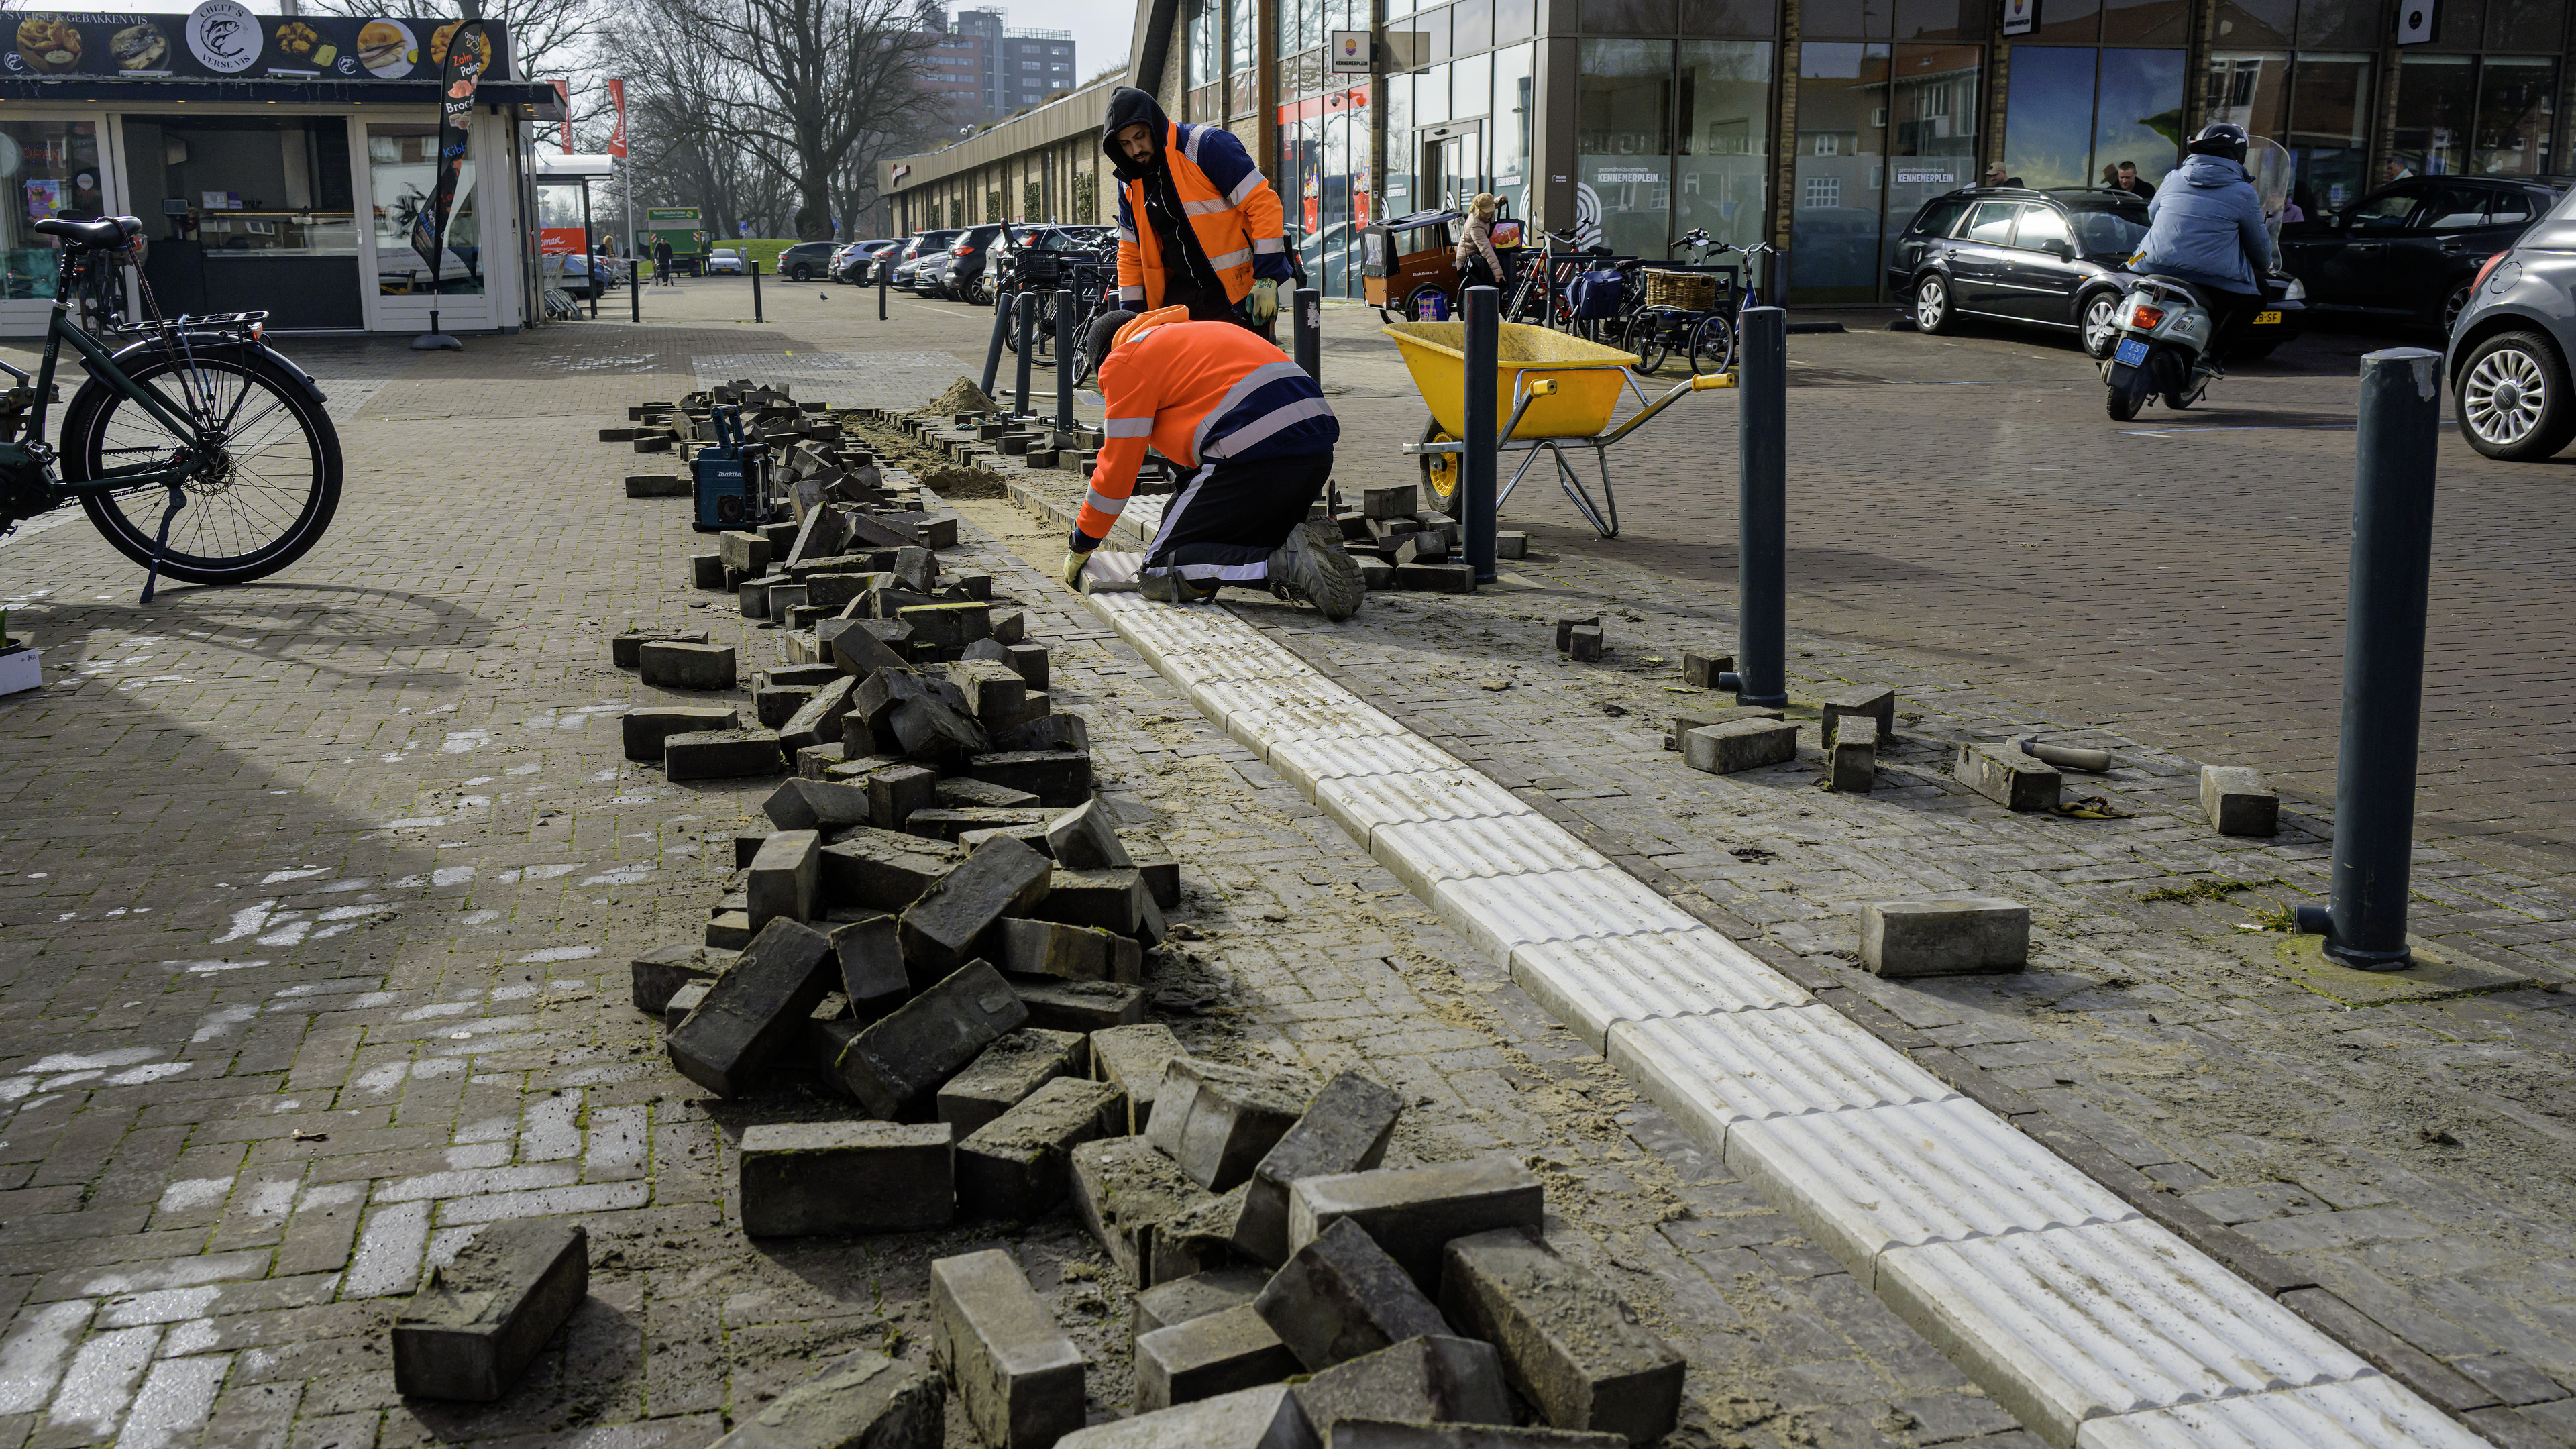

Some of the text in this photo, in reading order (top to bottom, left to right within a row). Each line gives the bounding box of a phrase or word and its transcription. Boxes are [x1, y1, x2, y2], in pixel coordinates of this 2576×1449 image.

[16, 11, 53, 21] VERSE
[56, 13, 65, 22] &
[66, 13, 127, 25] GEBAKKEN
[131, 15, 148, 25] VIS
[203, 54, 250, 68] VERSE VIS
[453, 52, 473, 66] Zalm
[21, 148, 61, 162] OPEN
[1597, 173, 1658, 182] KENNEMERPLEIN
[1897, 174, 1954, 182] KENNEMERPLEIN
